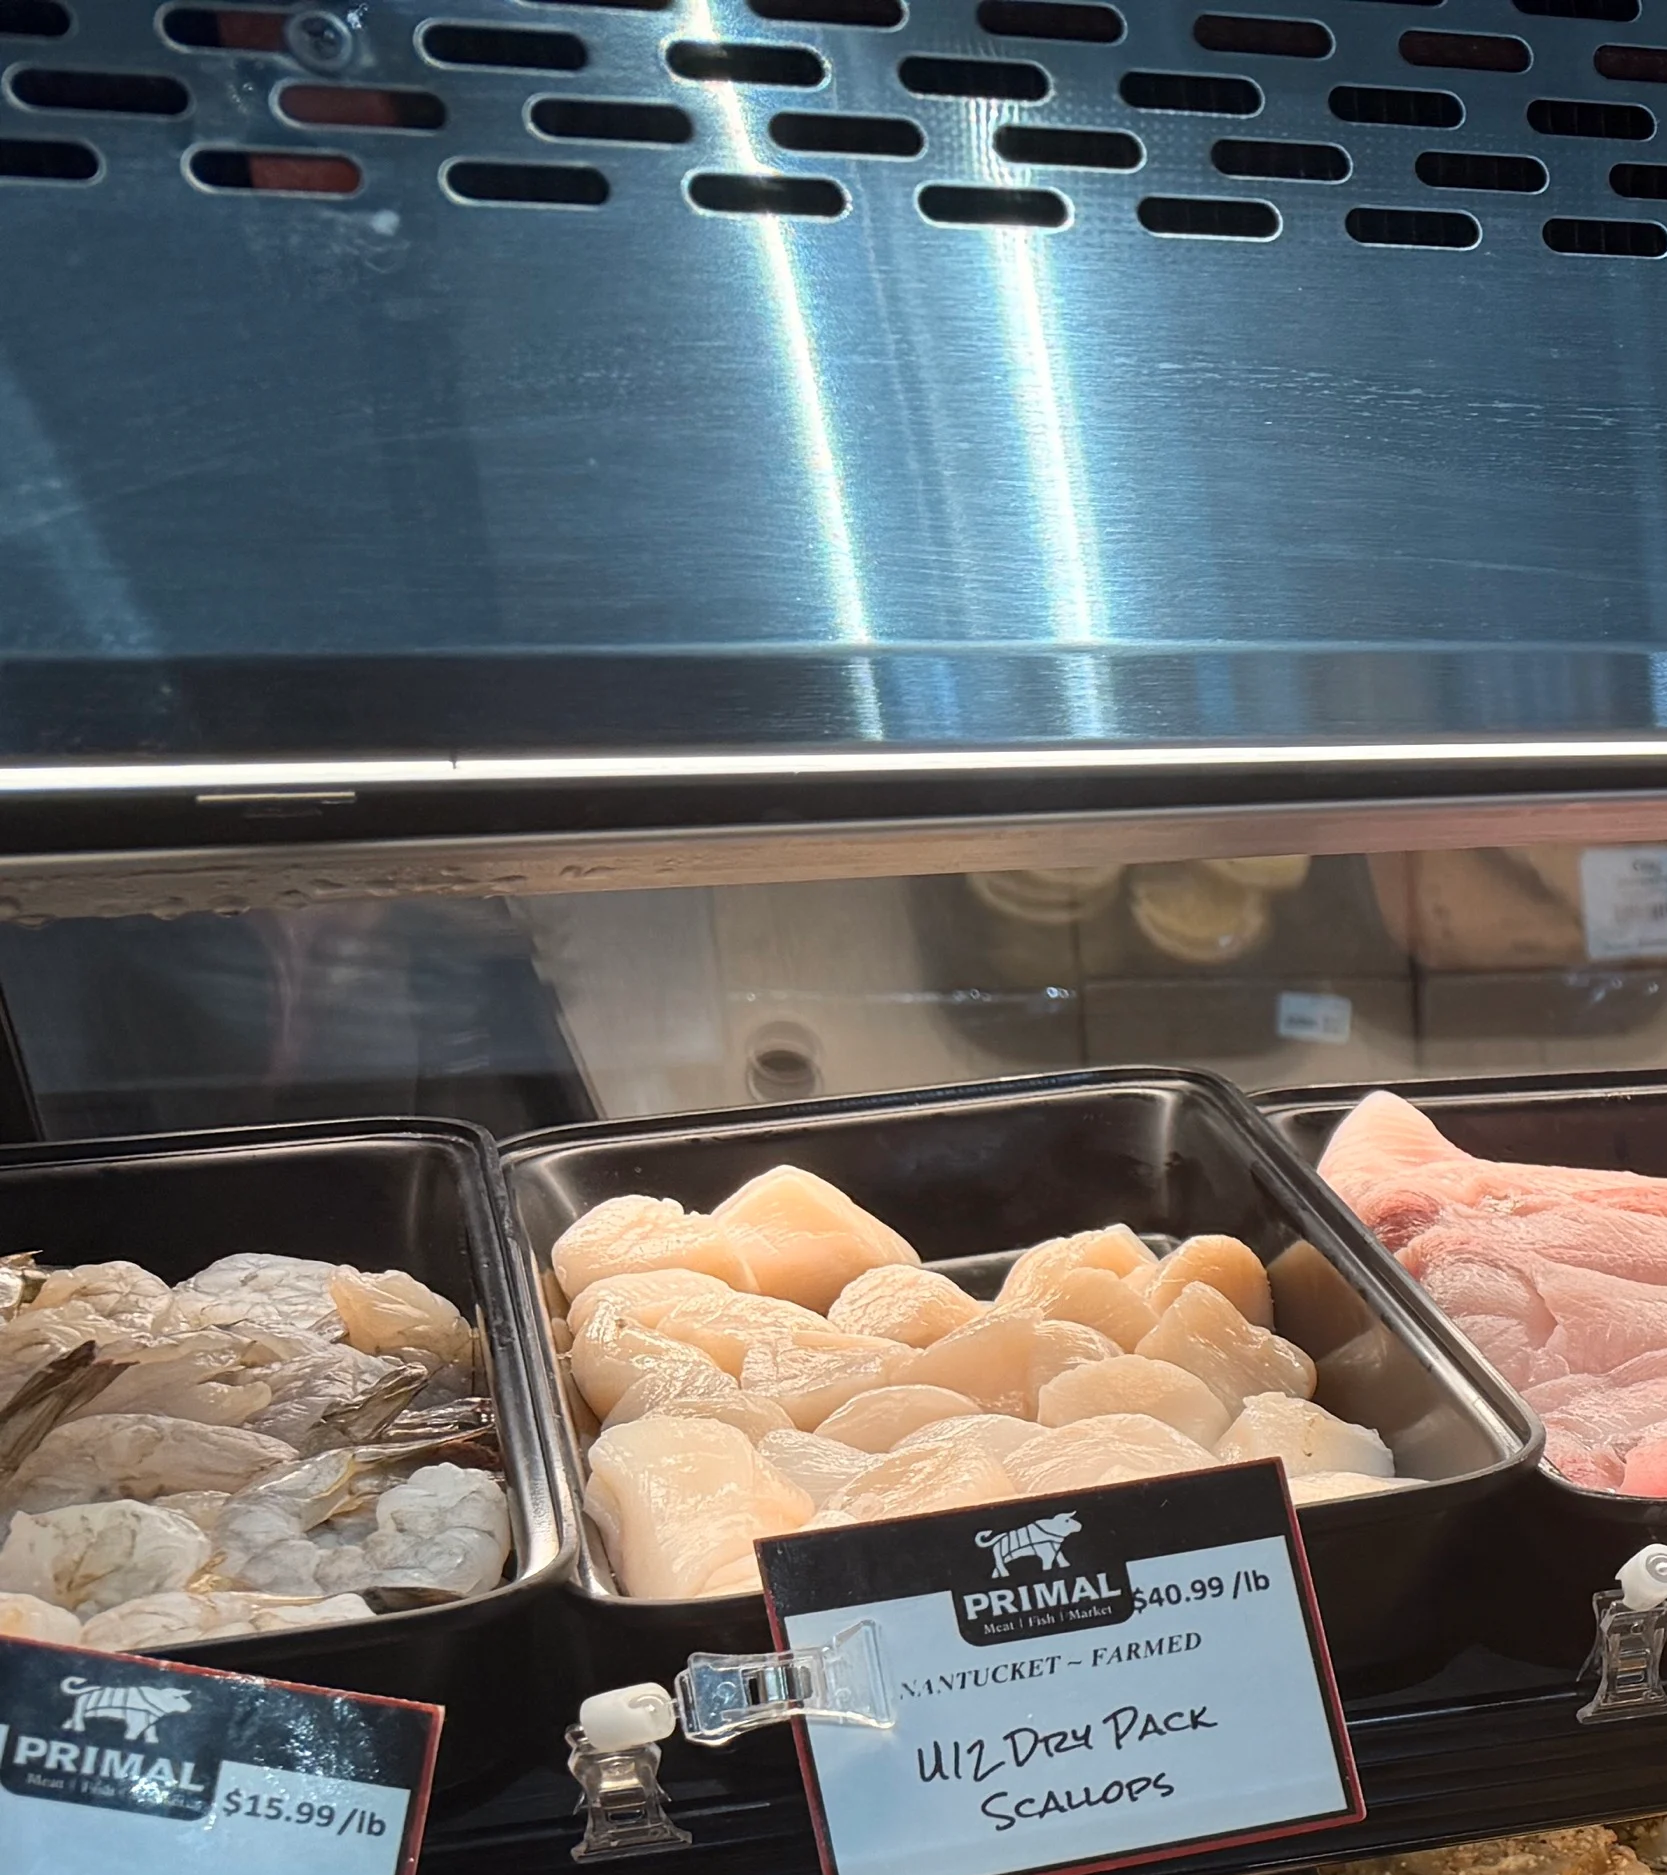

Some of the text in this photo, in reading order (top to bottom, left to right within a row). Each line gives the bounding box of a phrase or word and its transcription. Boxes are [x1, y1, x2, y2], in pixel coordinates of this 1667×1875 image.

[963, 1572, 1122, 1620] PRIMAL
[1133, 1570, 1270, 1613] $40.99 /lb
[983, 1606, 1112, 1635] Meat Fish Market
[900, 1632, 1201, 1699] NANTUCKET FARMED
[1004, 1728, 1091, 1768] DRY
[1104, 1706, 1218, 1751] PACK
[13, 1736, 204, 1792] PRIMAL
[223, 1789, 335, 1828] $15.99
[338, 1808, 386, 1836] /lb
[981, 1772, 1174, 1831] SCALLOPS
